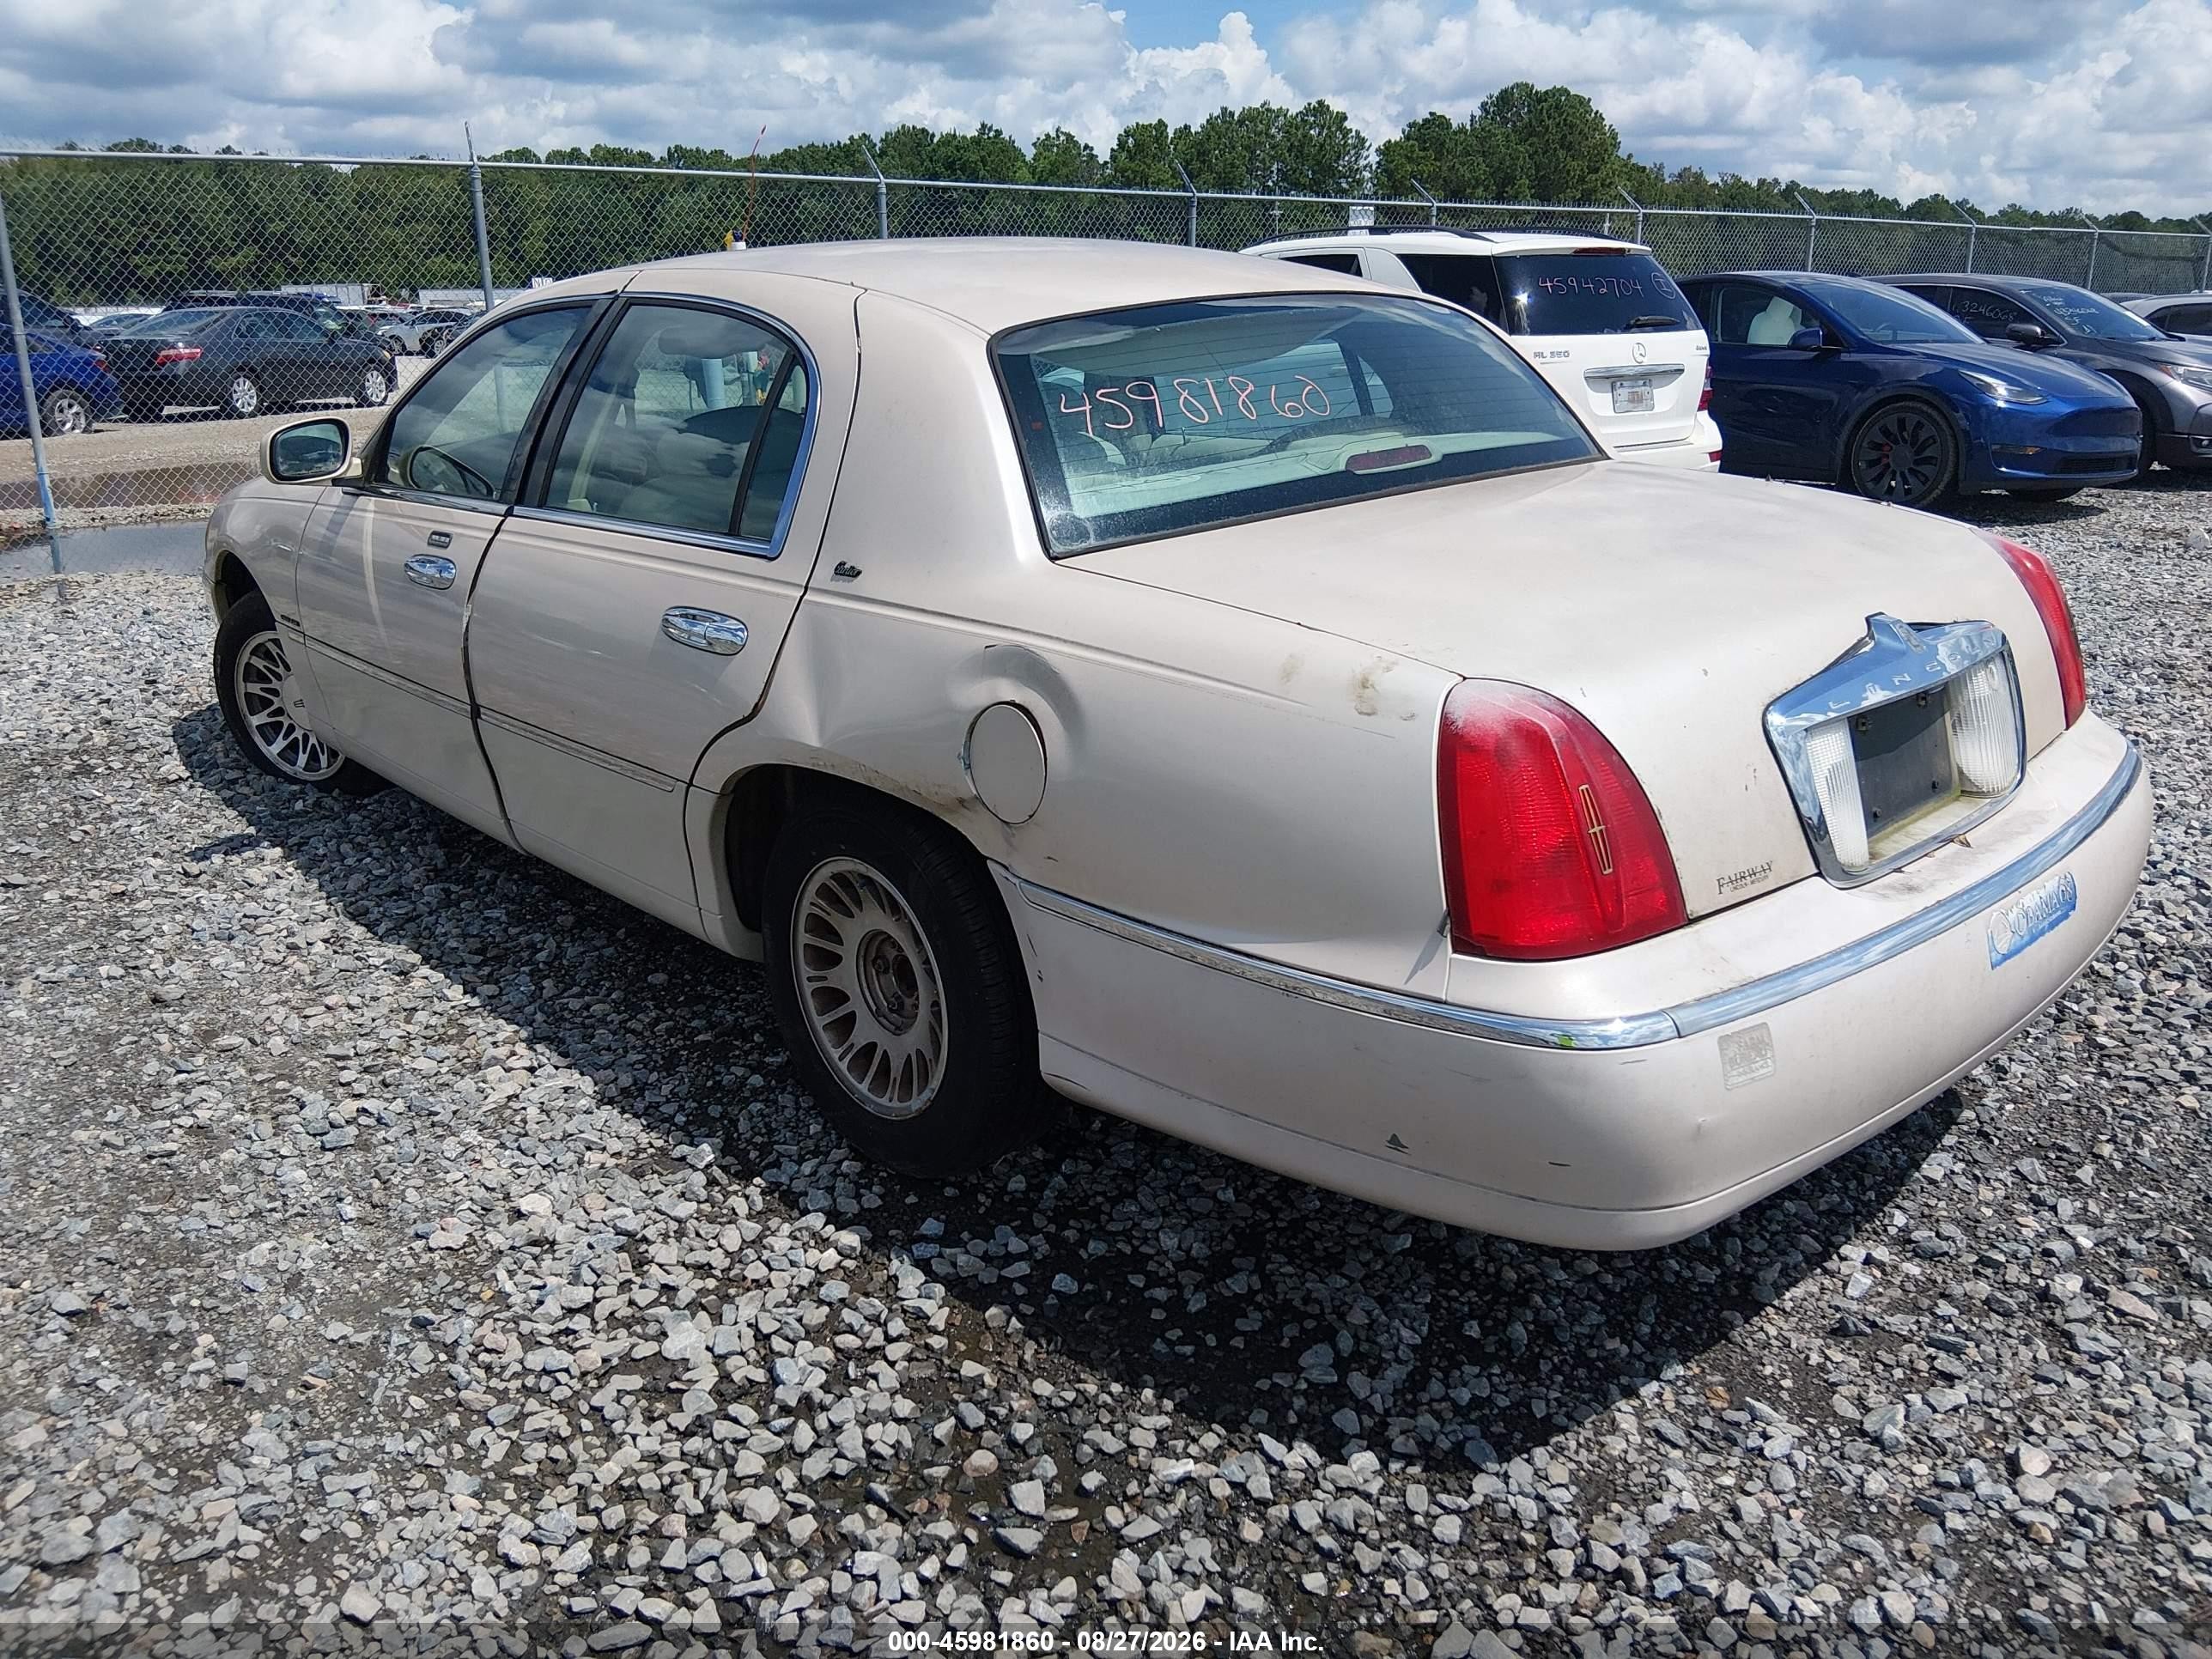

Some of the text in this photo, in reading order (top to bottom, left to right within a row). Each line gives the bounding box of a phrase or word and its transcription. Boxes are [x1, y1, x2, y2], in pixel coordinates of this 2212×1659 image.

[1539, 276, 1644, 298] 45942704
[1828, 635, 1996, 709] LINCOLN
[1716, 860, 1772, 895] FAIRWAY
